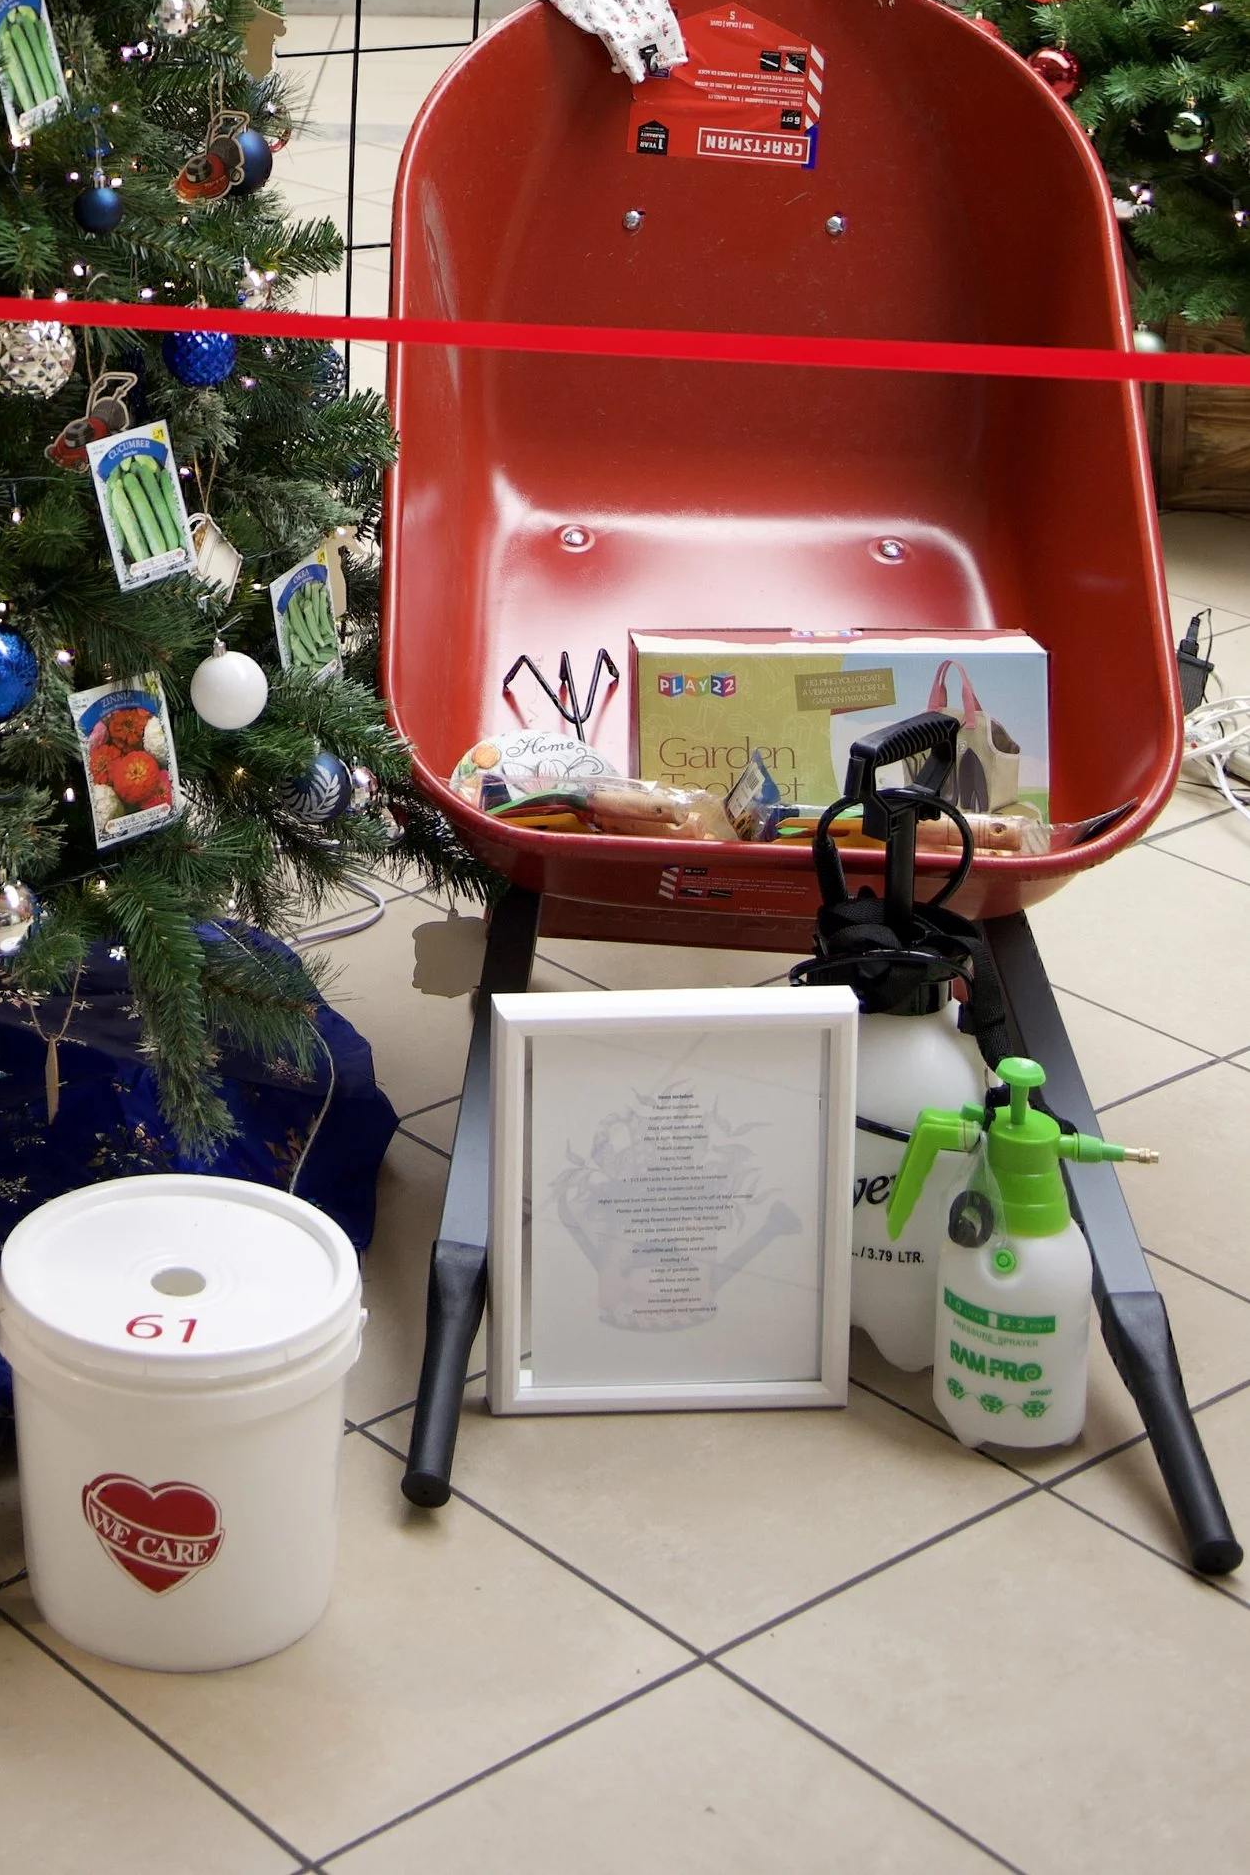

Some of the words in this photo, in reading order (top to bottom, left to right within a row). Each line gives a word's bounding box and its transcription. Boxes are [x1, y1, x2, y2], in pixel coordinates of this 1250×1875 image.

[794, 116, 801, 125] 6
[639, 141, 657, 149] YEAR
[705, 135, 803, 156] CRAFTSMAN
[108, 438, 150, 460] CUCUMBER
[293, 568, 309, 584] OKRA
[658, 676, 736, 696] PLAY22
[805, 676, 837, 687] HELPING
[837, 675, 854, 686] YOU
[854, 674, 883, 684] CREATE
[808, 685, 840, 696] VIBRANT
[846, 682, 887, 694] COLORFUL
[812, 695, 843, 706] GARDEN
[845, 692, 880, 703] PARADISE
[506, 737, 575, 758] Home
[659, 736, 796, 770] Garden
[115, 812, 146, 827] AMERICAN
[868, 1248, 893, 1262] 3.79
[897, 1251, 925, 1263] LTR.
[125, 1314, 198, 1344] 61
[1002, 1318, 1026, 1330] 2.2
[953, 1317, 994, 1341] PRESSURE
[997, 1336, 1039, 1348] SPRAYER
[89, 1502, 130, 1546] WE
[136, 1535, 210, 1564] CARE
